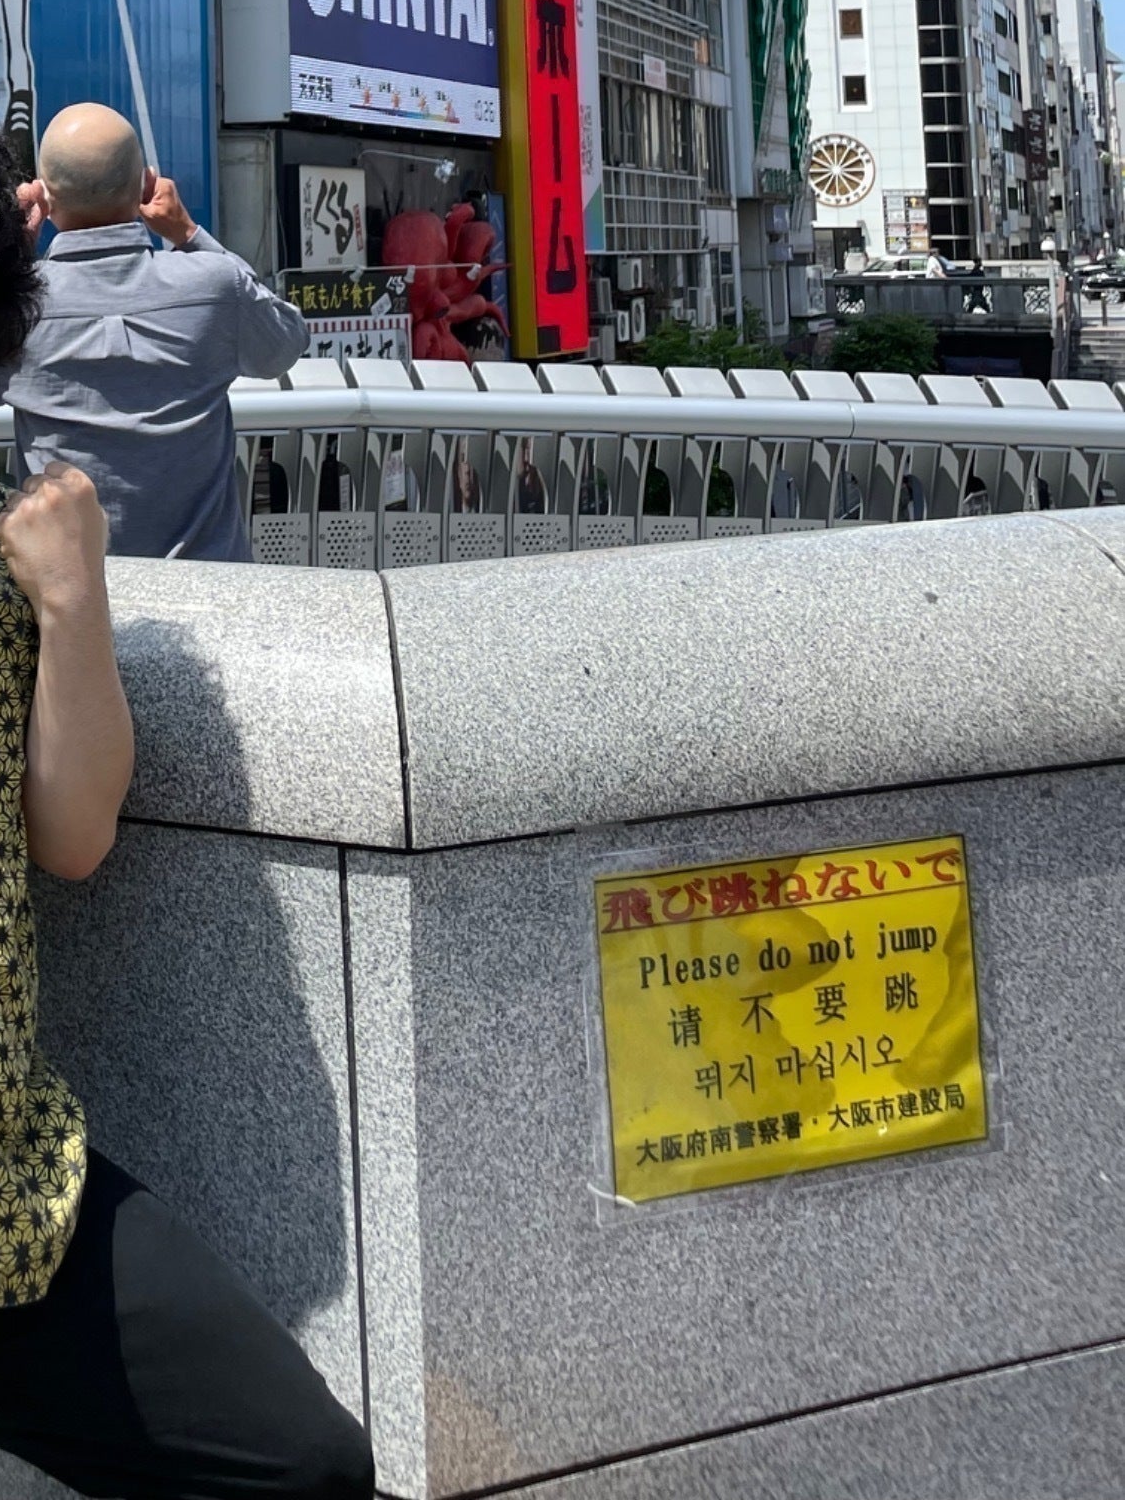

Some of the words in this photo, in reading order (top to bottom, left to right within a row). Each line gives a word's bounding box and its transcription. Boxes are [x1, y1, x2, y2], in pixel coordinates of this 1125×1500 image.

[601, 847, 962, 934] 飛び跳ねないで
[639, 952, 740, 989] Please
[759, 938, 792, 972] do
[808, 930, 855, 964] not
[877, 922, 937, 960] jump
[668, 972, 920, 1048] 请不要跳
[694, 1054, 756, 1100] 뛰지
[776, 1034, 903, 1086] 마십시오
